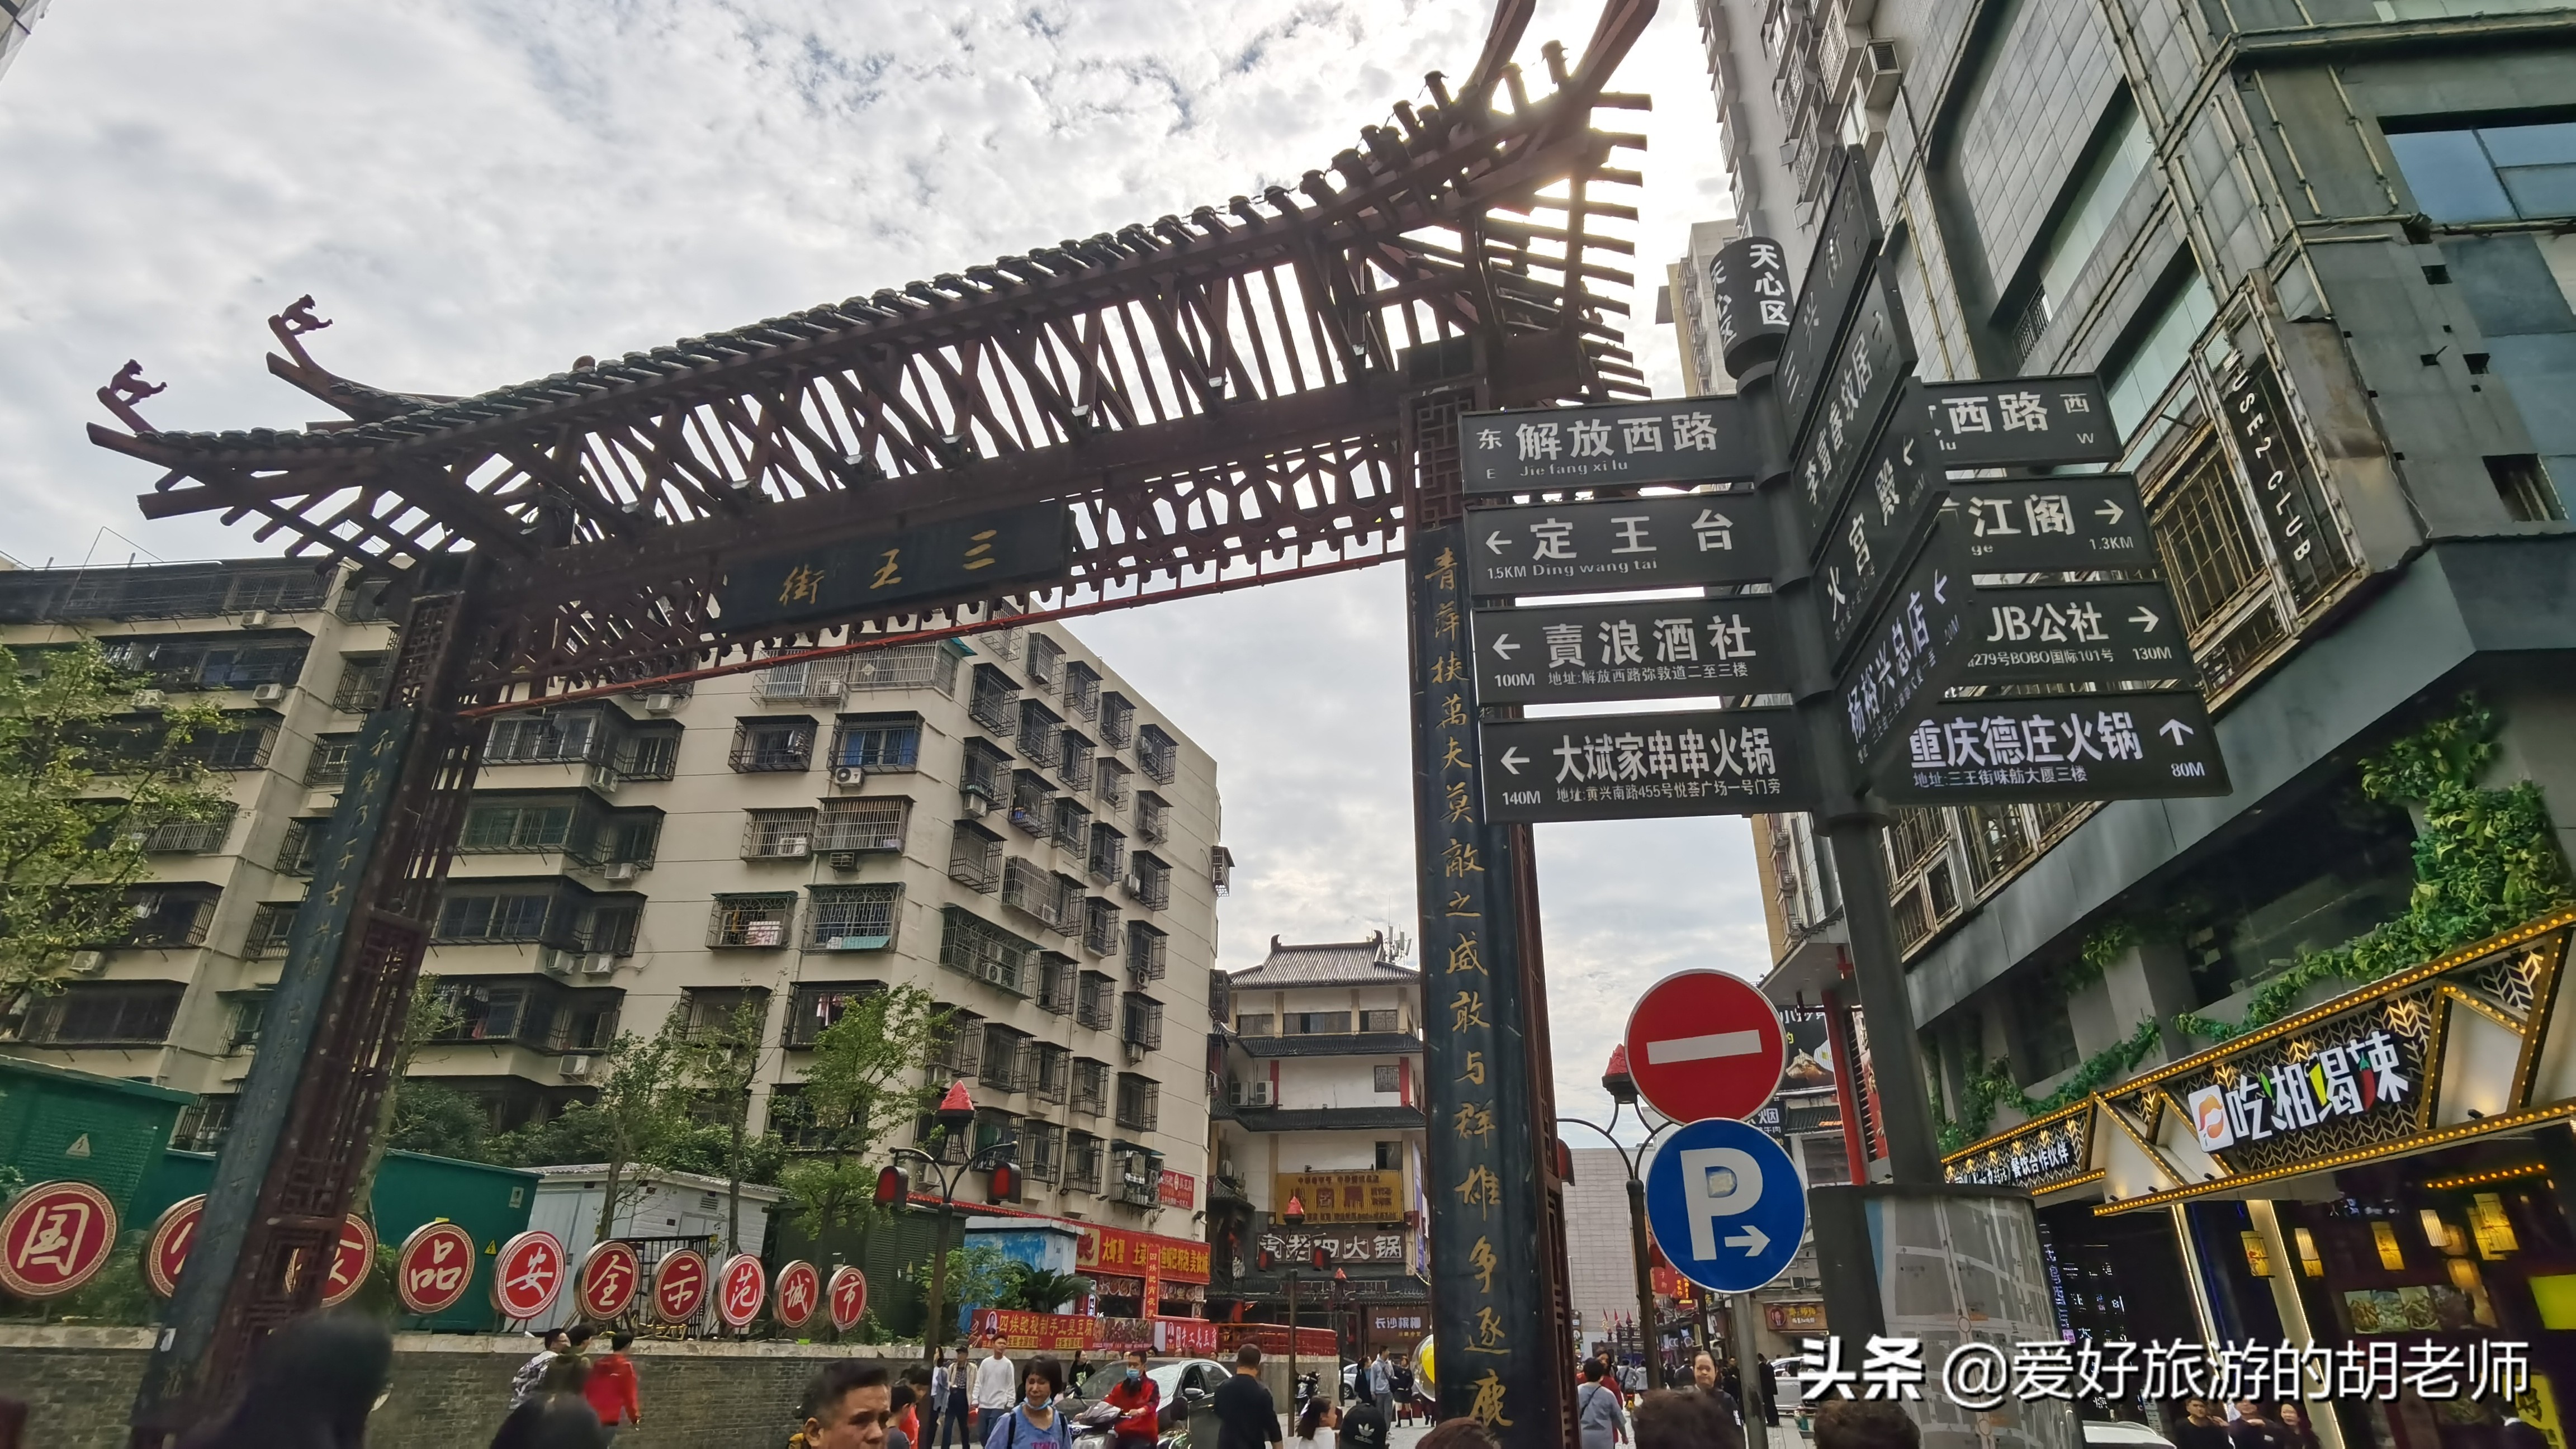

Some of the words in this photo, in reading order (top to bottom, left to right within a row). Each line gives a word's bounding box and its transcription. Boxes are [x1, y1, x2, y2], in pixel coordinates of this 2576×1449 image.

[1749, 244, 1791, 327] 天心区
[1805, 329, 1873, 506] 李富春故居
[1928, 392, 2049, 435] 西路
[2059, 392, 2090, 414] 西
[1476, 428, 1503, 450] 东
[1515, 411, 1718, 462] 解放西路
[2076, 433, 2095, 444] W
[1486, 468, 1497, 479] E
[1530, 509, 1734, 561] 定王台
[1943, 494, 2076, 537] 江阁
[2267, 470, 2311, 562] CLUB
[1827, 457, 1900, 622] 火宫殿
[2089, 536, 2134, 550] 1.3KM
[778, 529, 997, 607] 三王街
[1487, 565, 1527, 580] 1.5KM
[1986, 600, 2109, 643] JB公社
[1847, 589, 1930, 744] 杨裕兴总店
[1967, 647, 2114, 668] 279号BOBO国际101号
[2132, 646, 2173, 661] 130M
[1494, 673, 1536, 687] 100M
[1552, 726, 1776, 784] 大斌家串串火锅
[1909, 710, 2144, 769] 重庆德庄火锅
[2170, 761, 2206, 778] 80M
[1502, 790, 1542, 805] 140M
[1680, 1147, 1763, 1261] P
